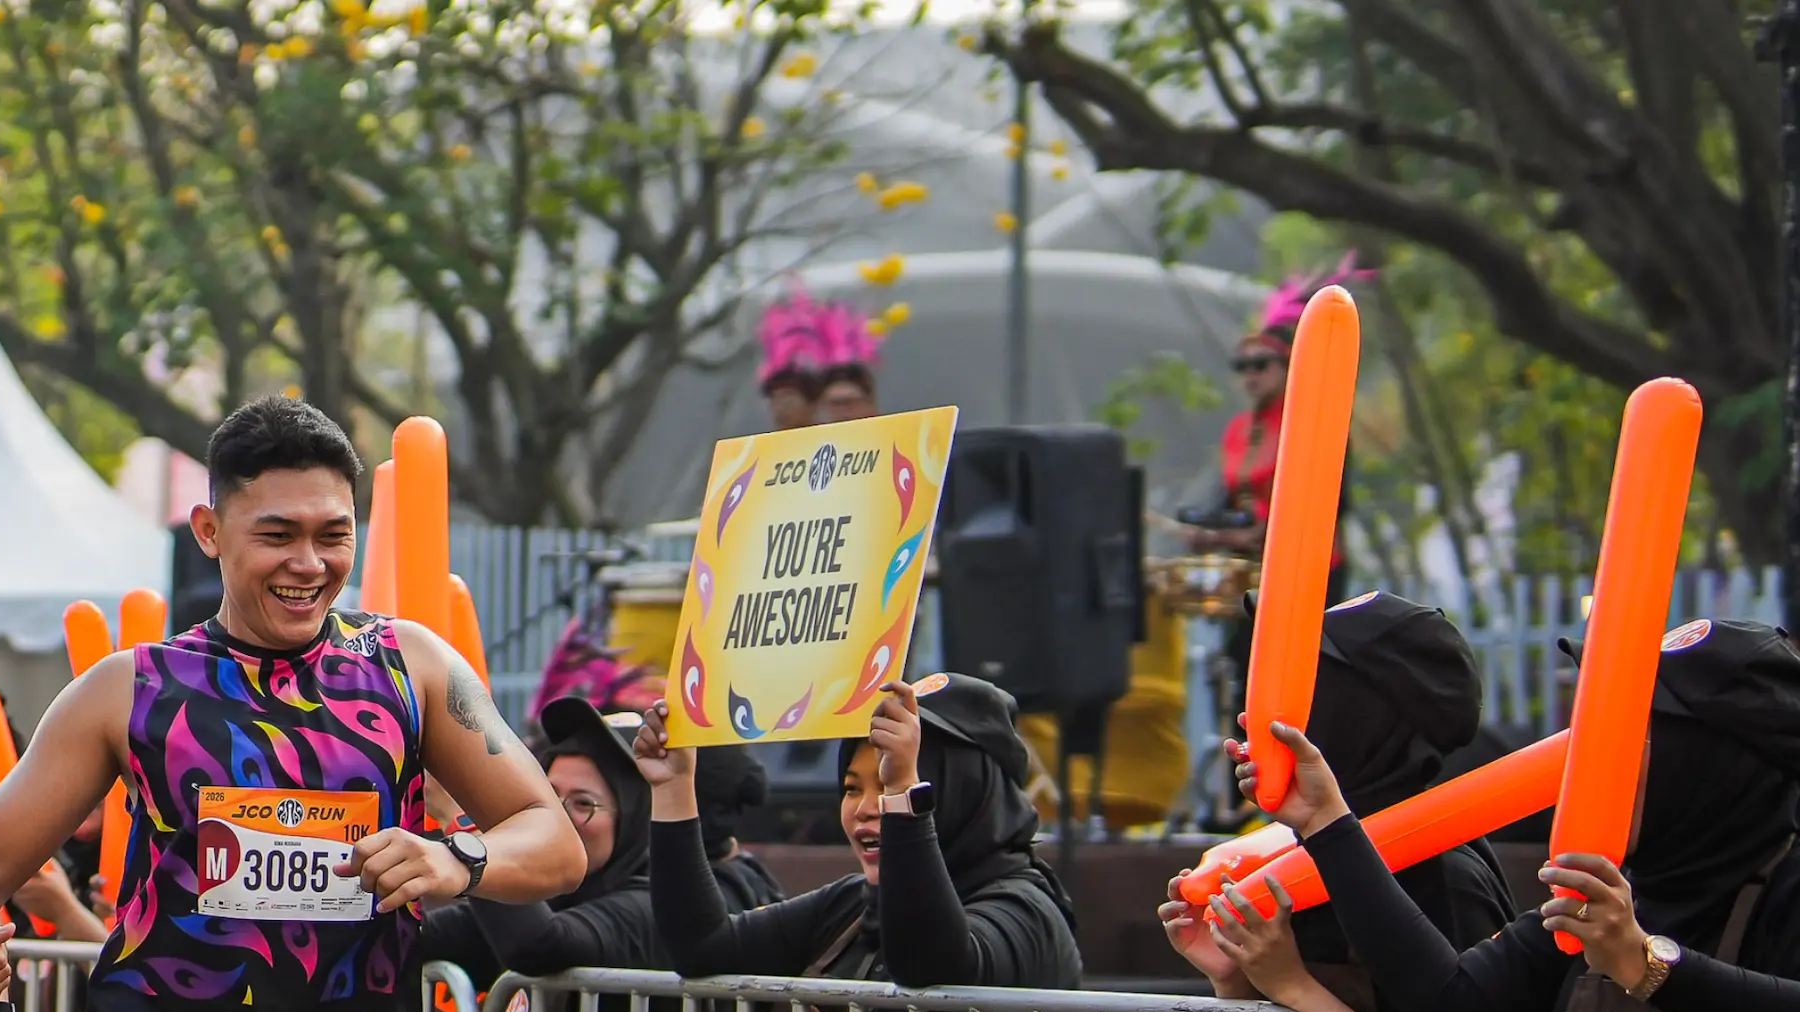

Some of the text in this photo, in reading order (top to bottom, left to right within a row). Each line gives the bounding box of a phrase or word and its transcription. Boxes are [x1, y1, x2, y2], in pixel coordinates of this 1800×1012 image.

[764, 449, 880, 487] JCO RUN
[762, 515, 852, 580] YOU'RE
[723, 583, 858, 650] AWESOME!
[231, 805, 346, 821] JCO RUN
[343, 824, 371, 842] 10K
[205, 846, 228, 881] M
[243, 849, 329, 893] 3085
